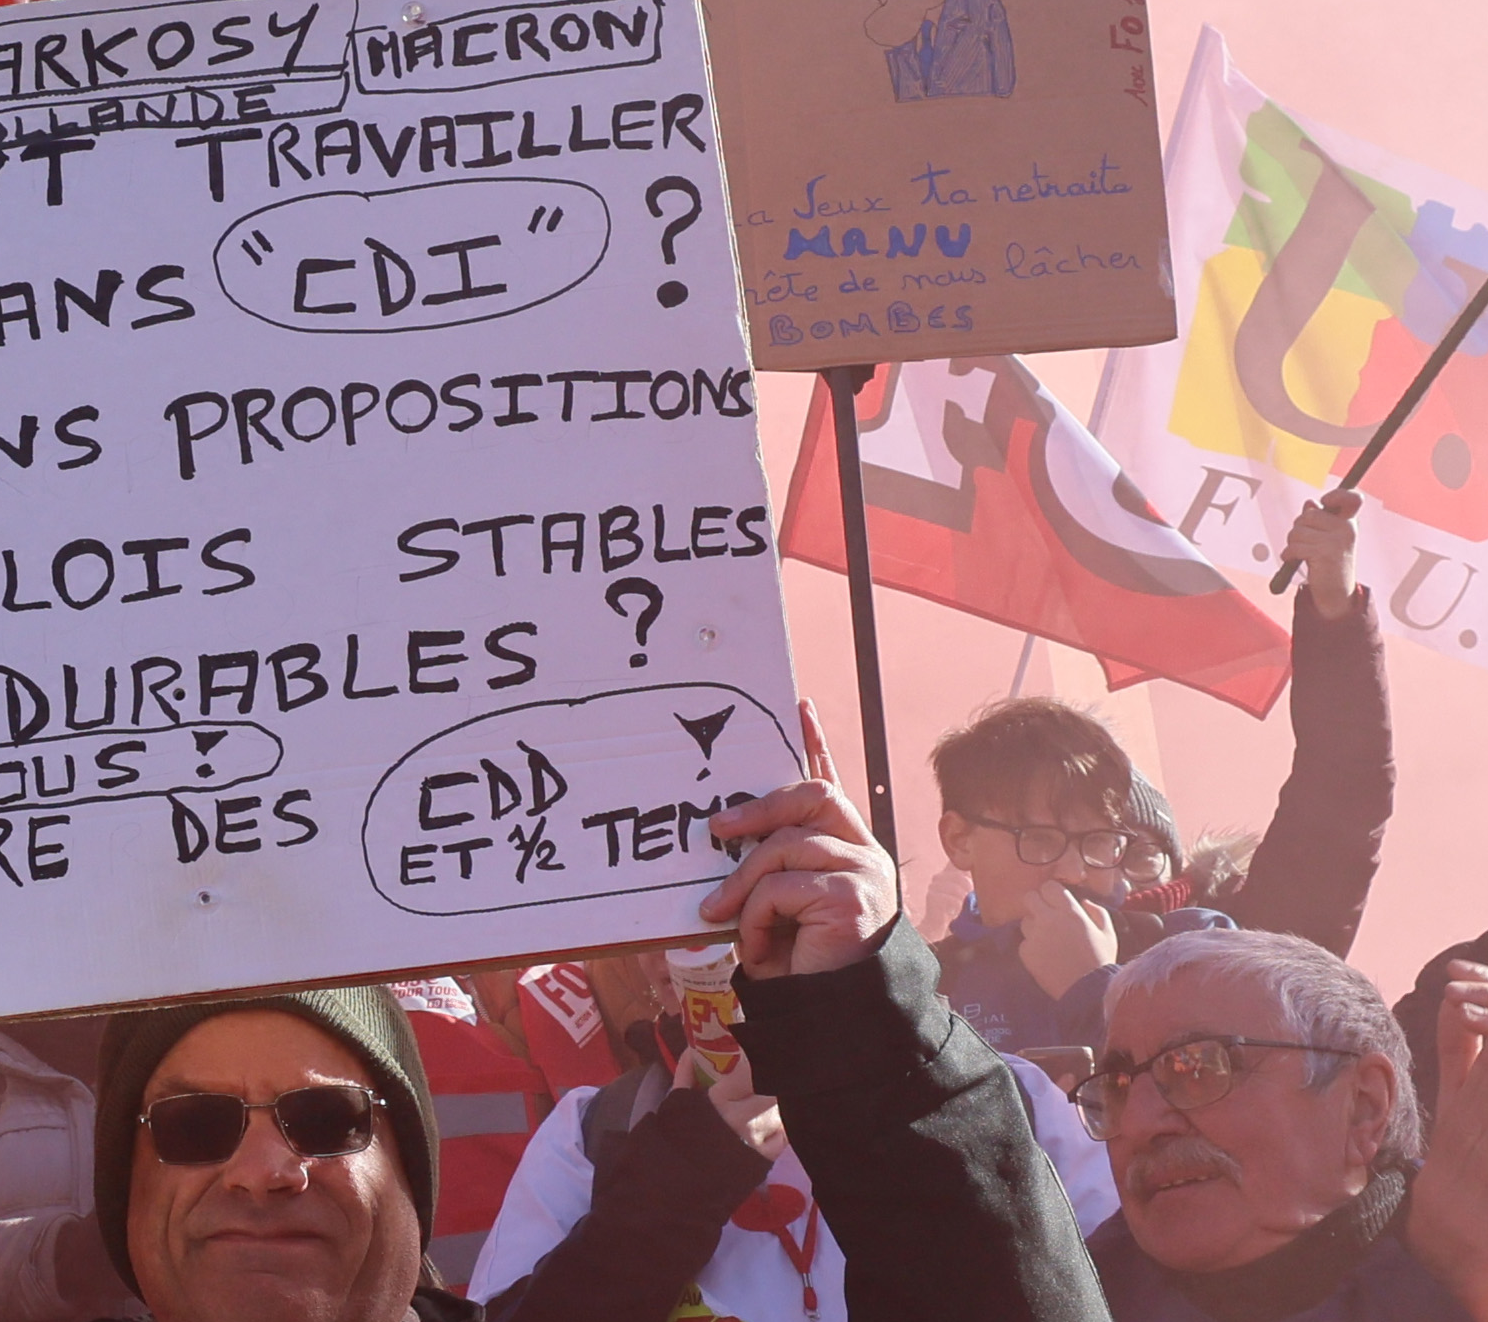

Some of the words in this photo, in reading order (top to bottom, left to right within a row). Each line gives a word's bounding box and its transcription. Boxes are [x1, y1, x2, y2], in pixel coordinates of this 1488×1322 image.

[364, 7, 652, 84] MACRON
[1109, 16, 1145, 54] FO
[176, 93, 708, 204] TRAVAILLER
[644, 173, 703, 308] ?
[838, 270, 879, 294] de
[768, 301, 973, 347] BOMBES
[165, 363, 756, 480] PROPOSITIONS
[397, 504, 769, 583] STABLES
[604, 576, 666, 670] ?
[420, 740, 568, 831] CDD
[172, 791, 320, 862] DES
[400, 838, 493, 886] ET
[534, 963, 592, 1018] FO
